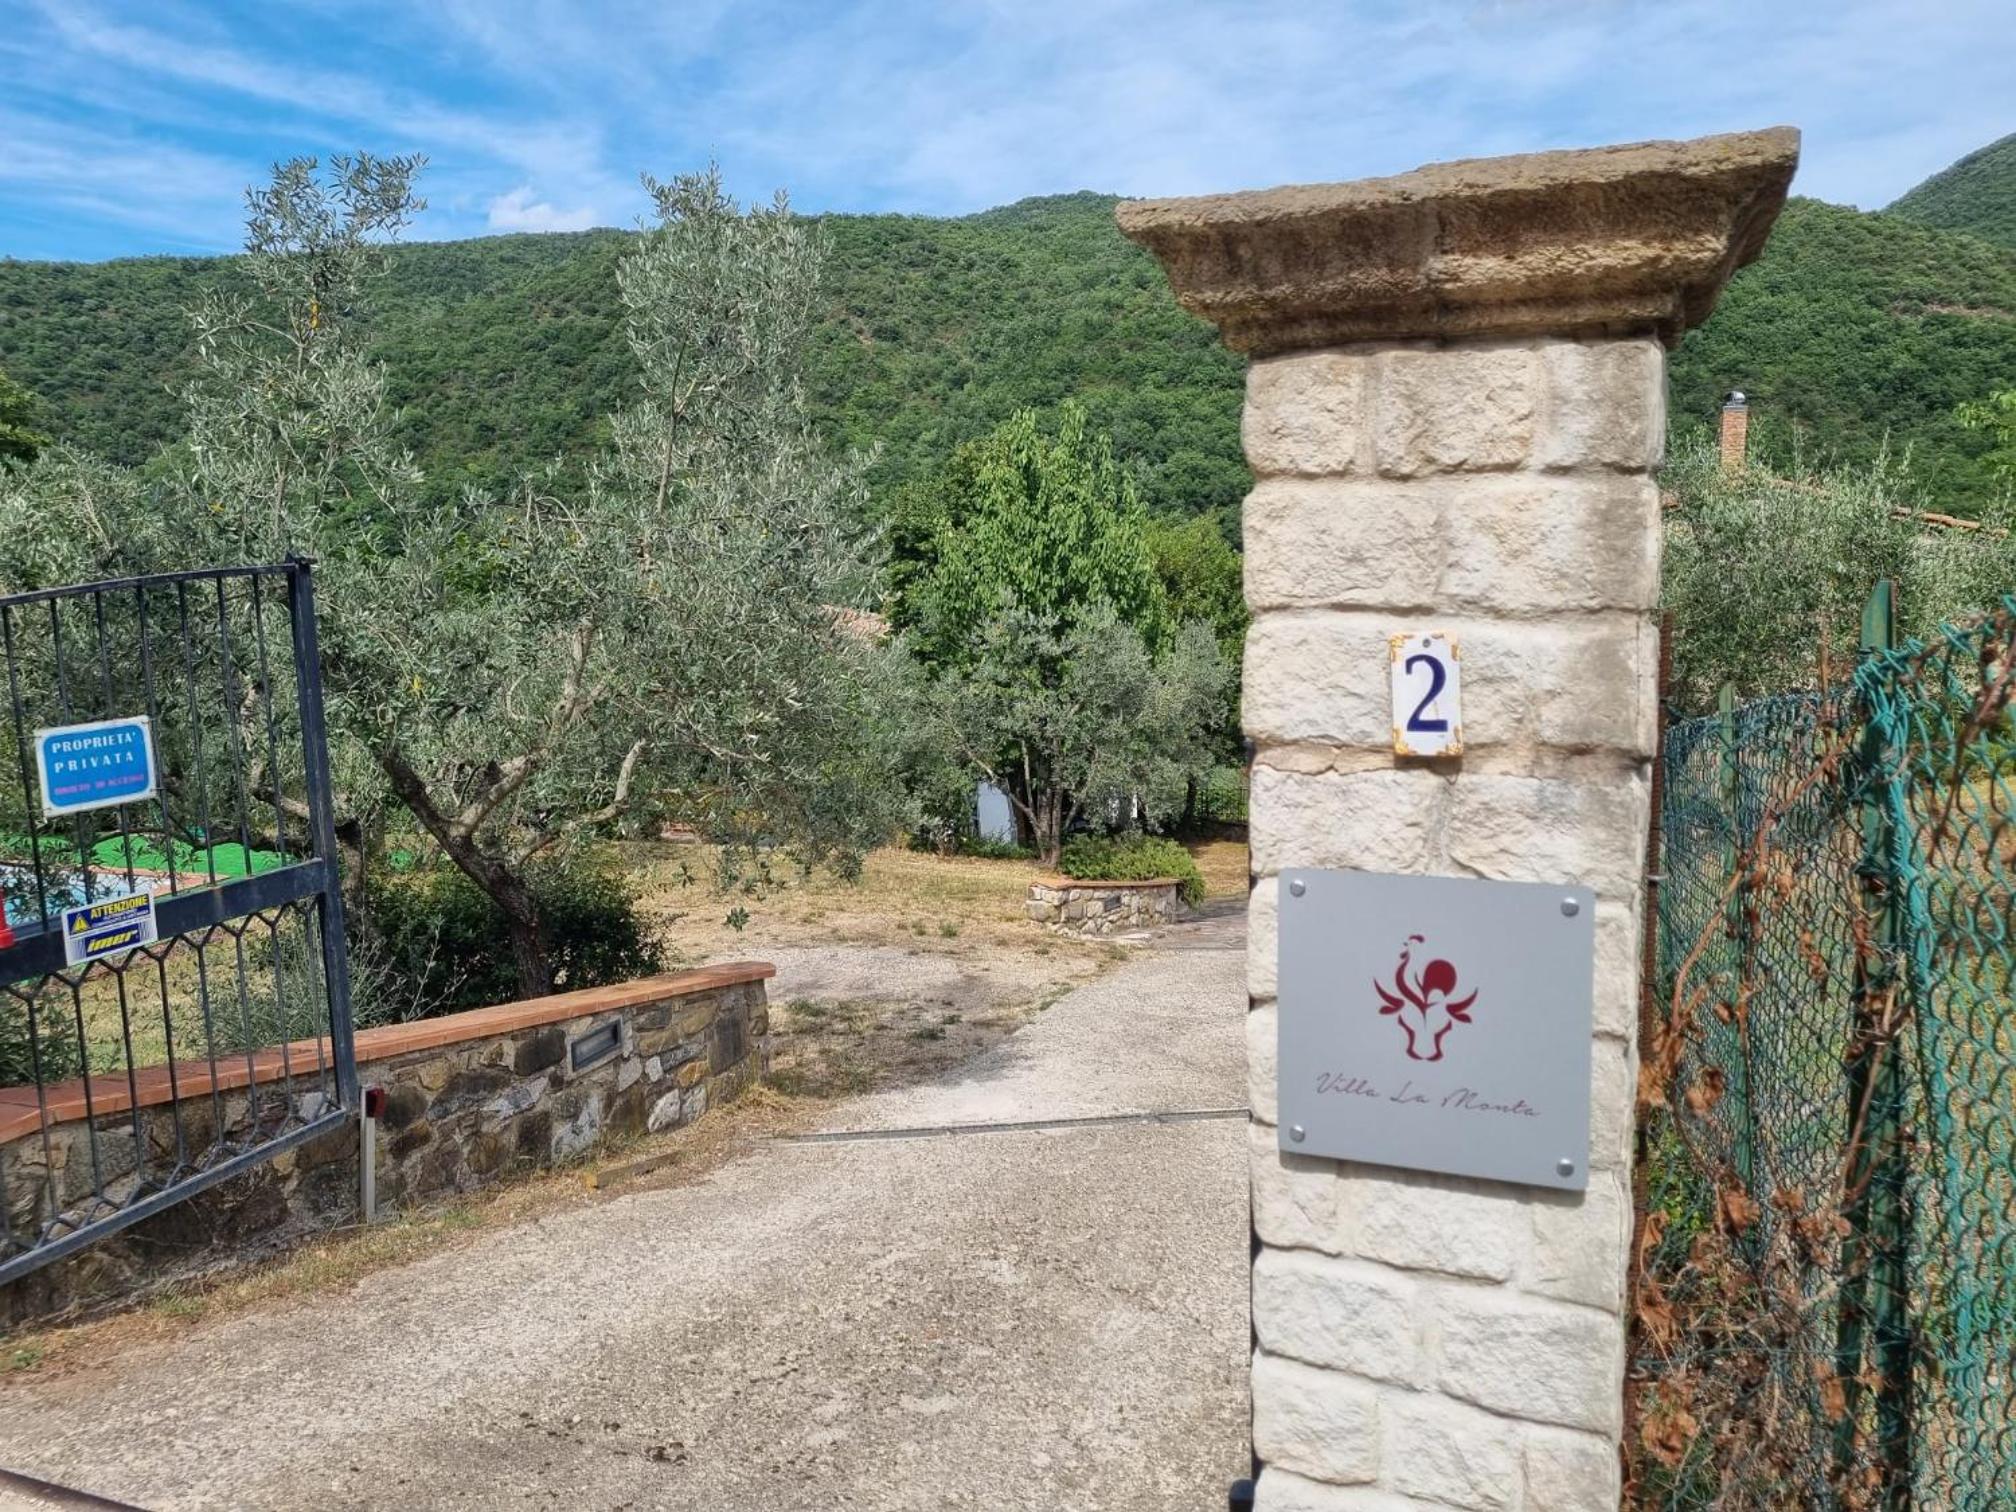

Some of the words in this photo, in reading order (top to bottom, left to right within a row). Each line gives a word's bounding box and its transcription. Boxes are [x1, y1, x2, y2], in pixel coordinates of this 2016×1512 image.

[1405, 653, 1448, 732] 2
[54, 751, 134, 774] PRIVATA
[90, 895, 149, 919] ATTENZIONE
[1316, 1072, 1380, 1096] Villa
[1390, 1080, 1430, 1104] La
[1441, 1087, 1541, 1117] Monta
